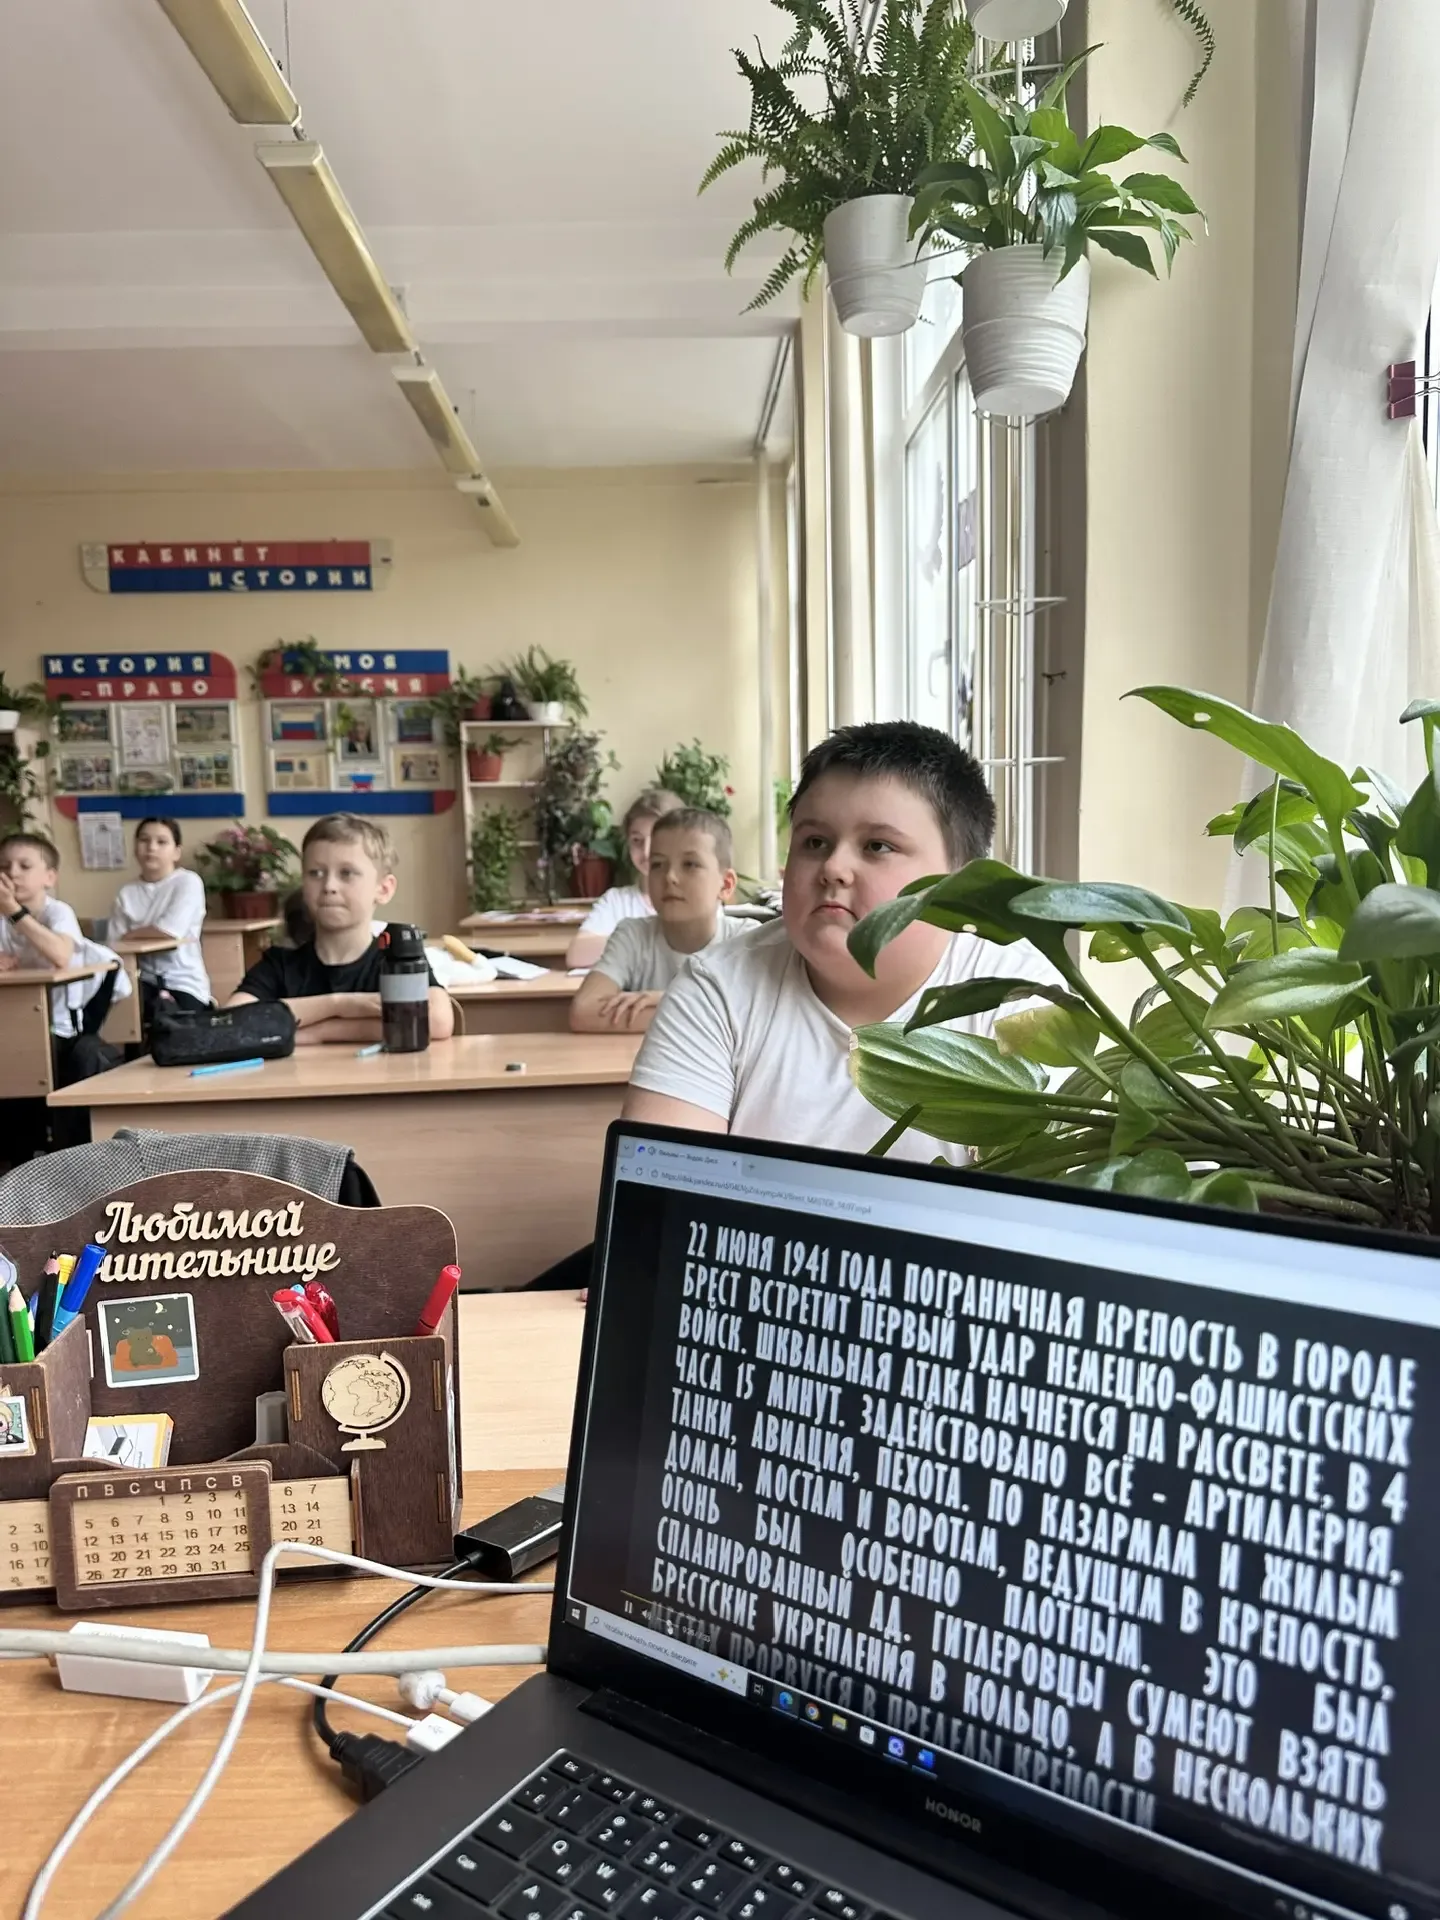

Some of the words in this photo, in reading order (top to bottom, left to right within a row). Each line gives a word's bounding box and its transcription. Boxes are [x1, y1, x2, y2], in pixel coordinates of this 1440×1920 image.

[113, 546, 268, 565] КАБИНЕТ
[208, 569, 367, 587] ИСТОРИИ
[48, 657, 206, 675] ИСТОРИЯ
[333, 653, 397, 670] МОЯ
[95, 1200, 305, 1244] Любимой
[96, 1242, 341, 1282] чительнице
[687, 1220, 708, 1258] 22
[715, 1226, 774, 1272] ИЮНЯ
[783, 1240, 829, 1284] 1941
[838, 1249, 892, 1301] ГОДА
[903, 1262, 1085, 1339] ПОГРАНИЧНАЯ
[1095, 1300, 1244, 1371] КРЕПОСТЬ
[1256, 1331, 1280, 1379] В
[1292, 1338, 1417, 1411] ГОРОДЕ
[682, 1261, 741, 1308] БРЕСТ
[748, 1275, 852, 1334] ВСТРЕТИТ
[859, 1291, 956, 1361] ПЕРВЫЙ
[968, 1323, 1036, 1378] УДАР
[1046, 1341, 1413, 1468] НЕМЕЦКО-ФАШИСТСКИХ
[678, 1303, 747, 1355] ВОЙСК.
[755, 1321, 893, 1393] ШКВАЛЬНАЯ
[900, 1356, 975, 1415] АТАКА
[985, 1377, 1118, 1450] НАЧНЕТСЯ
[1127, 1411, 1166, 1463] НА
[1176, 1422, 1334, 1511] РАССВЕТЕ,
[1346, 1461, 1370, 1512] В
[1381, 1471, 1408, 1522] 4
[675, 1344, 722, 1392] ЧАСА
[735, 1362, 756, 1400] 15
[766, 1369, 845, 1428] МИНУТ.
[859, 1387, 1067, 1489] ЗАДЕЙСТВОВАНО
[1084, 1440, 1137, 1507] ВСЁ
[1183, 1478, 1403, 1587] АРТИЛЛЕРИЯ,
[77, 1486, 88, 1498] П
[104, 1484, 114, 1496] В
[129, 1482, 140, 1494] С
[155, 1480, 165, 1492] Ч
[181, 1479, 192, 1490] П
[206, 1477, 217, 1488] С
[232, 1475, 242, 1487] В
[284, 1486, 292, 1496] 6
[308, 1484, 317, 1494] 7
[160, 1496, 165, 1505] 1
[184, 1494, 192, 1504] 2
[208, 1492, 217, 1502] 3
[234, 1490, 242, 1500] 4
[280, 1503, 296, 1514] 13
[306, 1501, 320, 1512] 14
[85, 1519, 93, 1529] 5
[111, 1517, 119, 1527] 6
[136, 1515, 144, 1525] 7
[160, 1513, 169, 1523] 8
[186, 1511, 193, 1521] 9
[207, 1509, 222, 1520] 10
[234, 1507, 246, 1518] 11
[671, 1387, 737, 1446] ТАНКИ,
[751, 1410, 860, 1484] АВИАЦИЯ,
[875, 1445, 969, 1513] ПЕХОТА.
[987, 1477, 1023, 1527] ПО
[1039, 1492, 1197, 1580] КАЗАРМАМ
[1218, 1541, 1241, 1592] И
[1261, 1552, 1399, 1639] ЖИЛЫМ
[8, 1525, 17, 1535] 2
[33, 1523, 42, 1533] 3
[84, 1536, 98, 1547] 12
[109, 1534, 124, 1545] 13
[134, 1533, 148, 1543] 14
[160, 1531, 174, 1541] 15
[184, 1528, 198, 1539] 16
[208, 1526, 222, 1537] 17
[234, 1524, 247, 1535] 18
[281, 1520, 297, 1531] 20
[307, 1519, 321, 1529] 21
[10, 1542, 19, 1552] 9
[32, 1540, 48, 1551] 10
[308, 1536, 323, 1546] 28
[9, 1559, 24, 1570] 16
[34, 1557, 50, 1568] 17
[85, 1553, 100, 1564] 19
[111, 1551, 126, 1562] 20
[136, 1550, 150, 1560] 21
[160, 1548, 176, 1557] 22
[185, 1545, 200, 1556] 23
[209, 1544, 224, 1554] 24
[234, 1542, 250, 1552] 25
[87, 1571, 101, 1580] 26
[112, 1568, 128, 1579] 27
[136, 1566, 152, 1576] 28
[162, 1564, 177, 1575] 29
[186, 1562, 201, 1572] 30
[211, 1560, 226, 1570] 31
[664, 1430, 743, 1493] ДОМАМ,
[755, 1458, 843, 1522] МОСТАМ
[856, 1488, 873, 1531] И
[884, 1496, 1007, 1579] ВОРОТАМ,
[1022, 1538, 1163, 1624] ВЕДУЩИМ
[1179, 1585, 1203, 1634] В
[1217, 1596, 1394, 1703] КРЕПОСТЬ,
[661, 1472, 720, 1525] ОГОНЬ
[754, 1503, 801, 1555] БЫЛ
[840, 1531, 961, 1608] ОСОБЕННО
[1003, 1583, 1152, 1674] ПЛОТНЫМ.
[1202, 1646, 1257, 1709] ЭТО
[1312, 1682, 1390, 1756] БЫЛ
[657, 1515, 853, 1620] СПЛАНИРОВАННЫЙ
[869, 1589, 911, 1644] АД.
[931, 1610, 1105, 1712] ГИТЛЕРОВЦЫ
[1126, 1678, 1253, 1764] СУМЕЮТ
[1277, 1728, 1386, 1811] ВЗЯТЬ
[651, 1557, 759, 1631] БРЕСТСКИЕ
[771, 1600, 915, 1691] УКРЕПЛЕНИЯ
[929, 1659, 947, 1702] В
[963, 1671, 1075, 1758] КОЛЬЦО,
[1095, 1721, 1113, 1769] А
[1133, 1733, 1155, 1782] В
[1172, 1747, 1383, 1872] НЕСКОЛЬКИХ
[728, 1630, 855, 1710] ПРОРВУТСЯ
[861, 1682, 879, 1720] В
[886, 1691, 1004, 1770] ПРЕДЕЛЫ
[1011, 1740, 1157, 1832] КРЕПОСТИ
[565, 1761, 579, 1772] Esc
[924, 1796, 983, 1834] HONOR
[599, 1829, 614, 1841] 2
[643, 1852, 658, 1865] 3
[596, 1862, 617, 1879] W
